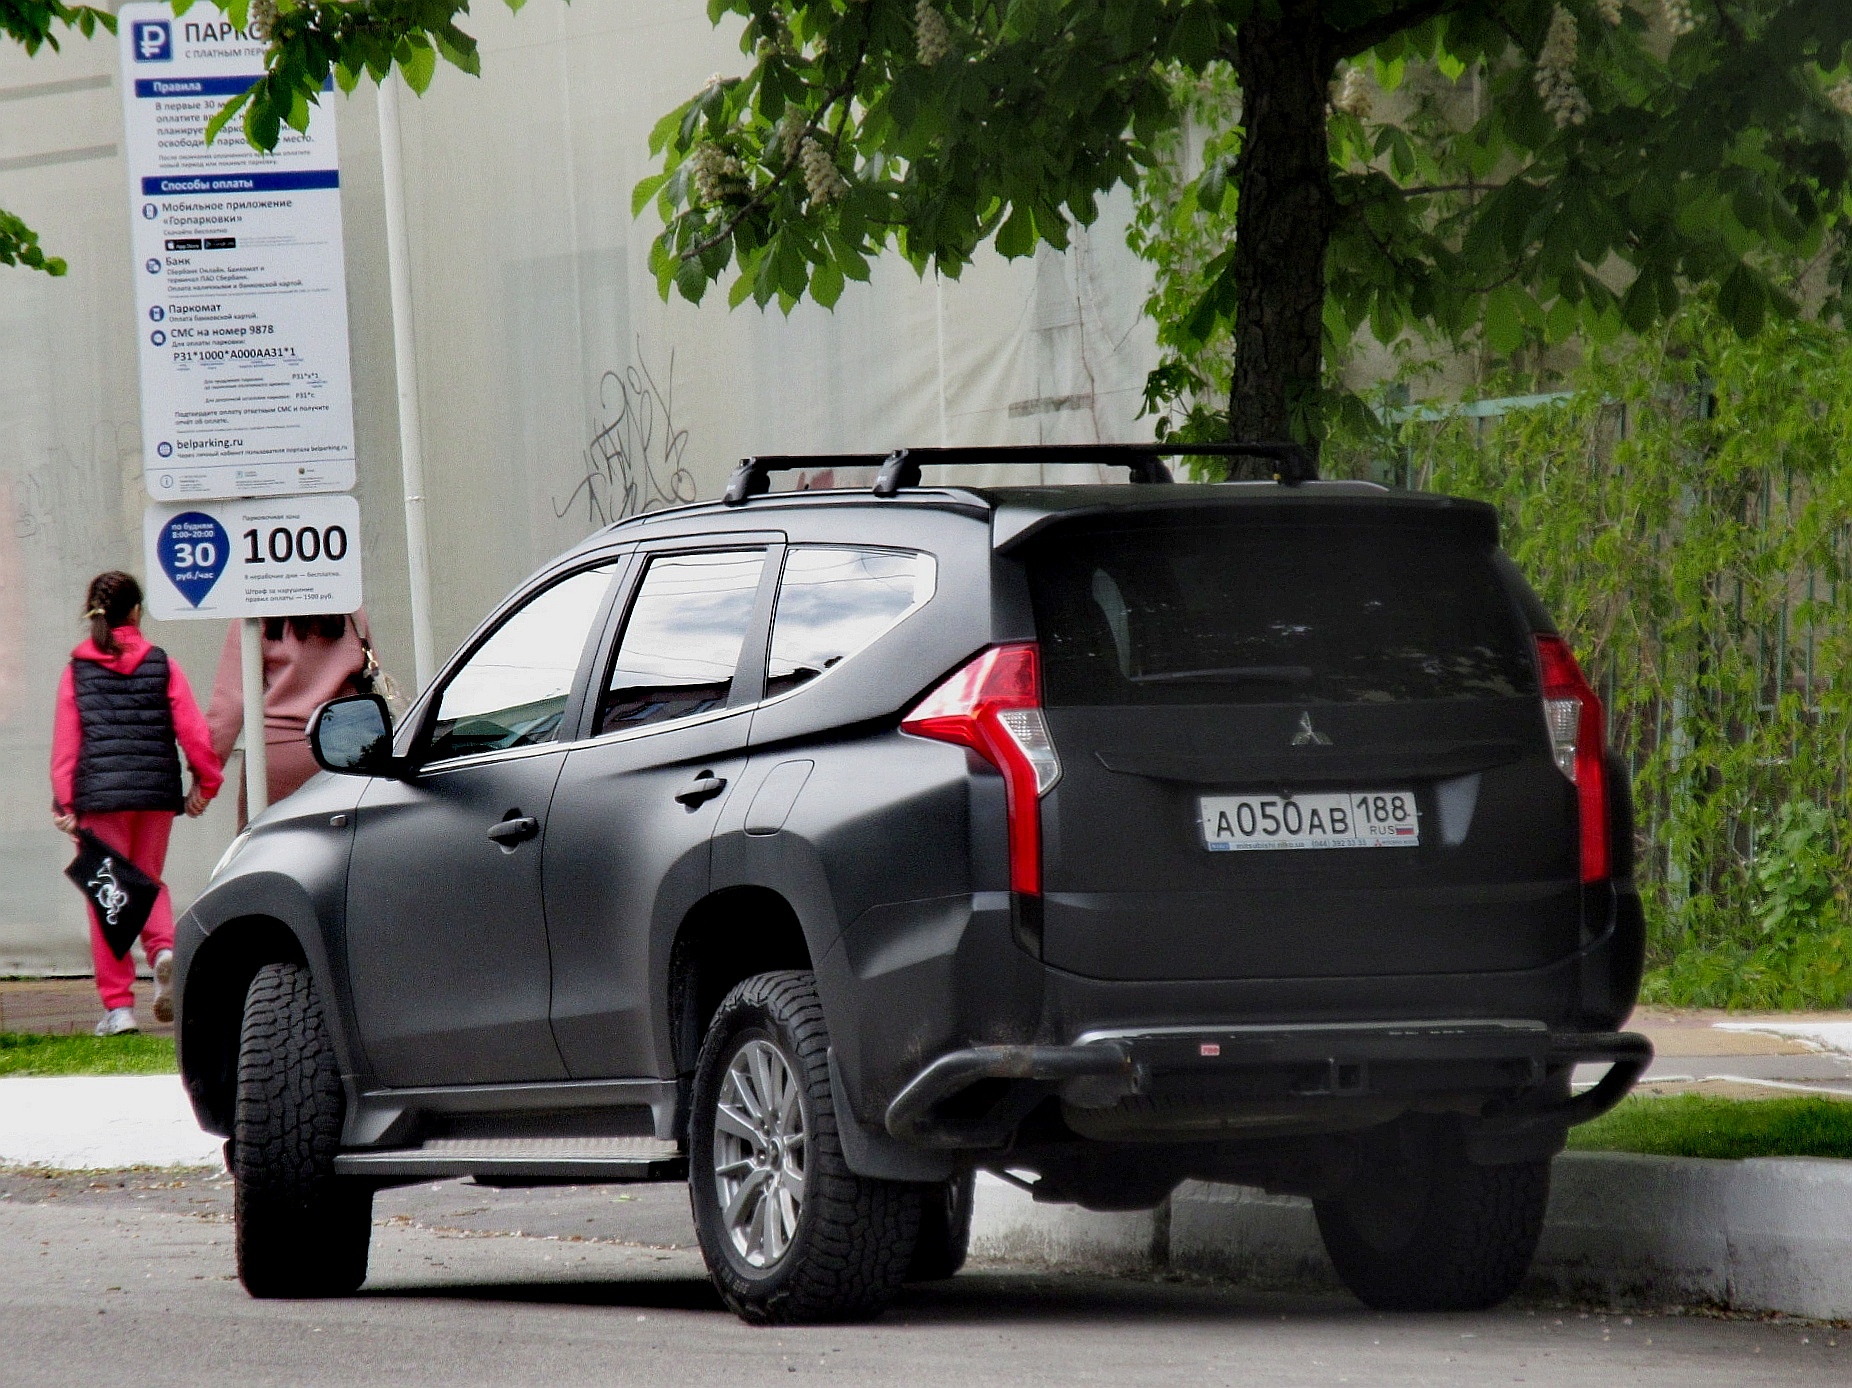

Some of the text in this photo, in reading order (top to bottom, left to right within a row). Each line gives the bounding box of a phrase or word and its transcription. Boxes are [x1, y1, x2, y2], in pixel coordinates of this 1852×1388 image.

[185, 21, 264, 42] ПАРКО
[193, 49, 241, 58] ПЛАТНЫМ
[153, 81, 202, 94] Правила
[155, 102, 161, 111] В
[164, 103, 201, 113] первые
[204, 101, 215, 109] 30
[156, 114, 199, 123] оплатите
[157, 126, 206, 136] планируе
[158, 137, 205, 148] освободи
[283, 134, 315, 144] место.
[161, 179, 253, 191] Способы оплаты
[162, 199, 292, 212] Мобильное приложение
[163, 215, 242, 226] «Горпарковки»
[165, 256, 191, 266] Банк
[168, 303, 221, 315] Паркомат
[170, 325, 274, 338] СМС на номер 9878
[277, 405, 292, 413] СМС
[299, 405, 330, 413] получите
[176, 438, 243, 450] belparking.ru
[311, 444, 348, 453] belparking.ru
[183, 522, 214, 531] будням
[243, 525, 348, 564] 1000
[174, 542, 216, 568] 30
[176, 570, 214, 581] руб./час
[245, 588, 268, 596] Штраф
[1356, 795, 1408, 824] 188
[1370, 825, 1395, 836] RUS
